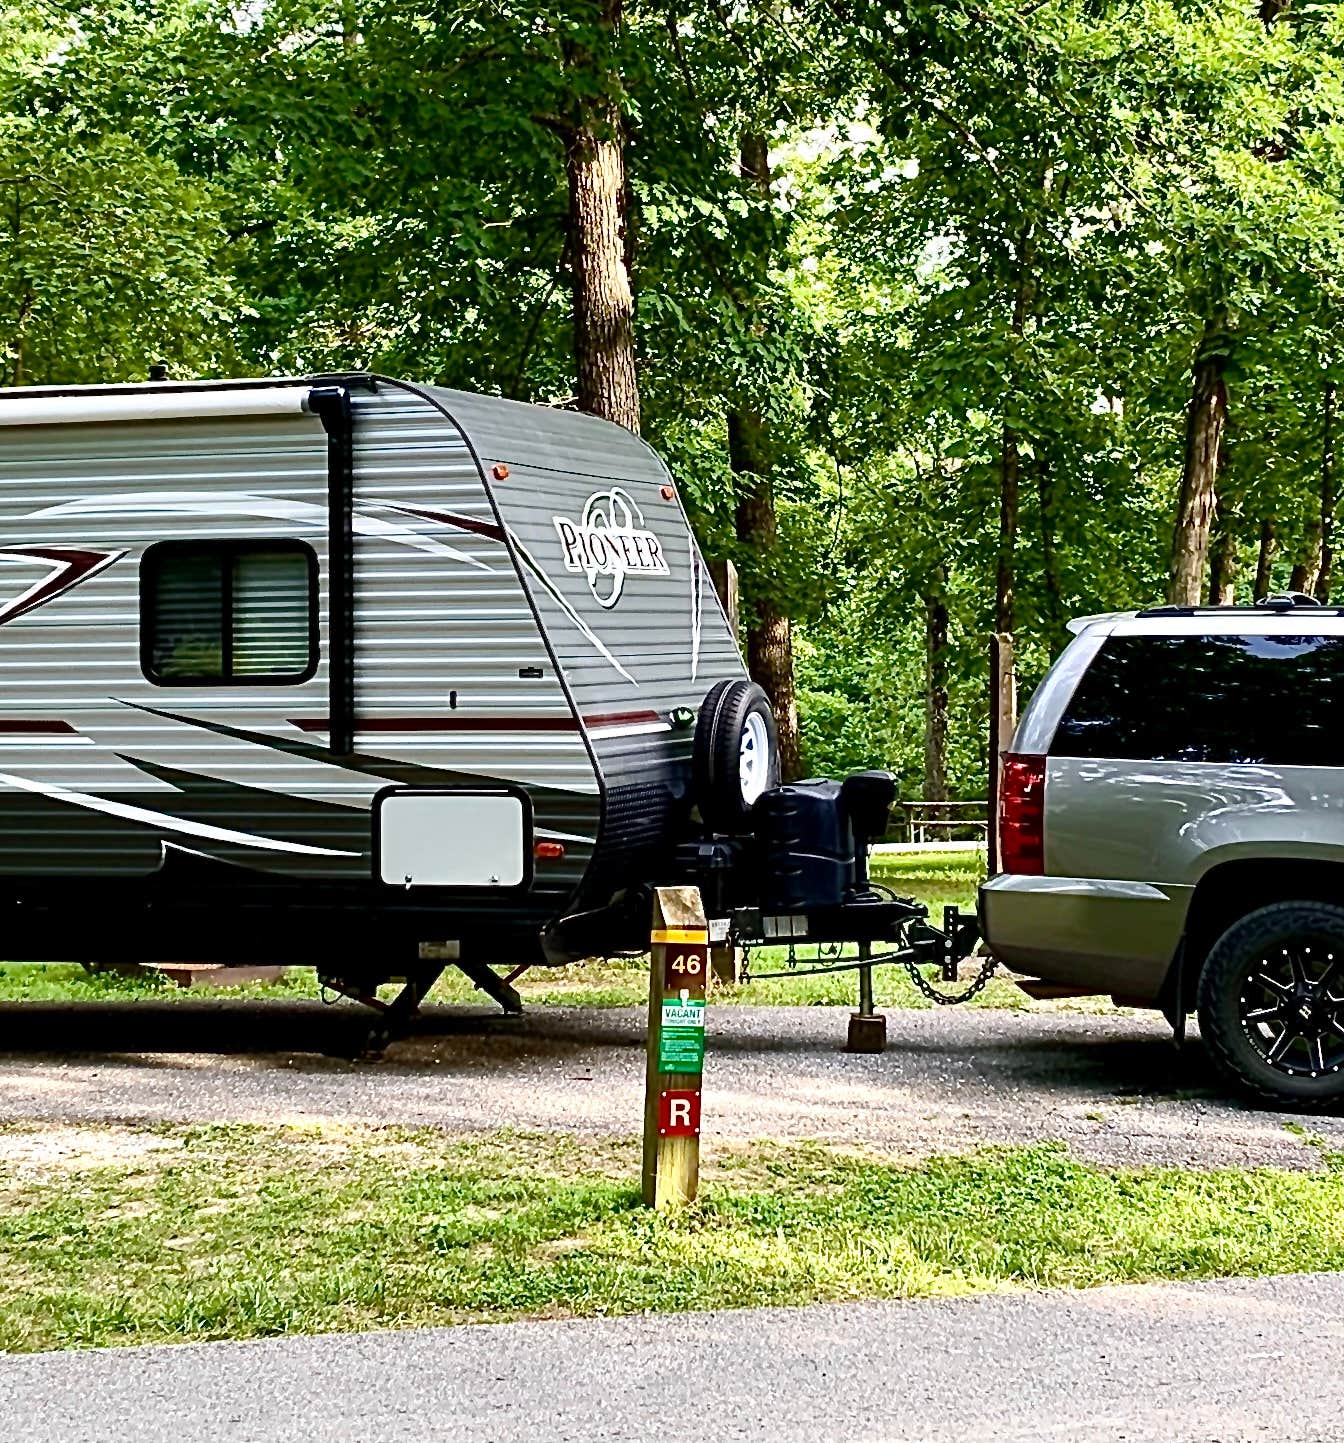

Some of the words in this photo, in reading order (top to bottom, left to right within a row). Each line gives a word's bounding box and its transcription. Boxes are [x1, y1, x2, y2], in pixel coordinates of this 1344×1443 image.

[557, 521, 666, 569] PIONEER
[671, 954, 701, 975] 46
[665, 1008, 701, 1018] VACANT
[670, 1099, 691, 1127] R
